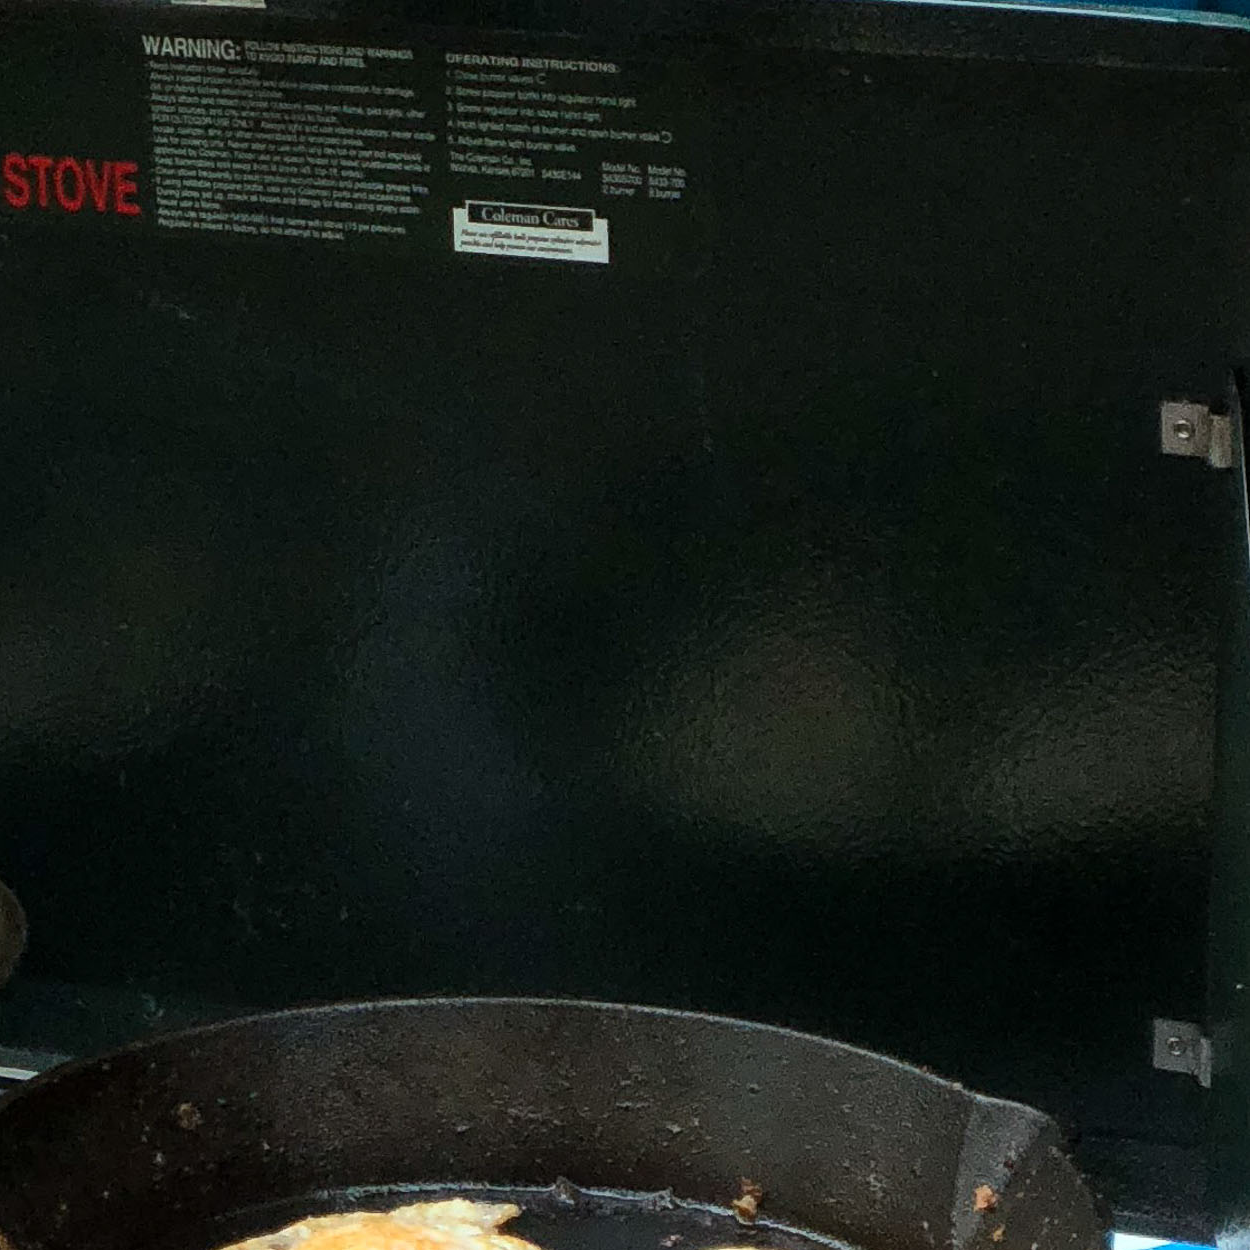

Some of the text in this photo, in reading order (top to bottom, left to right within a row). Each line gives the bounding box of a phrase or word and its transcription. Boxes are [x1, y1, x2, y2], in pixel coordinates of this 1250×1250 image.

[142, 35, 241, 61] WARNING:
[445, 53, 519, 68] OPERATING
[3, 151, 142, 217] STOVE
[481, 206, 580, 228] Coleman Cares
